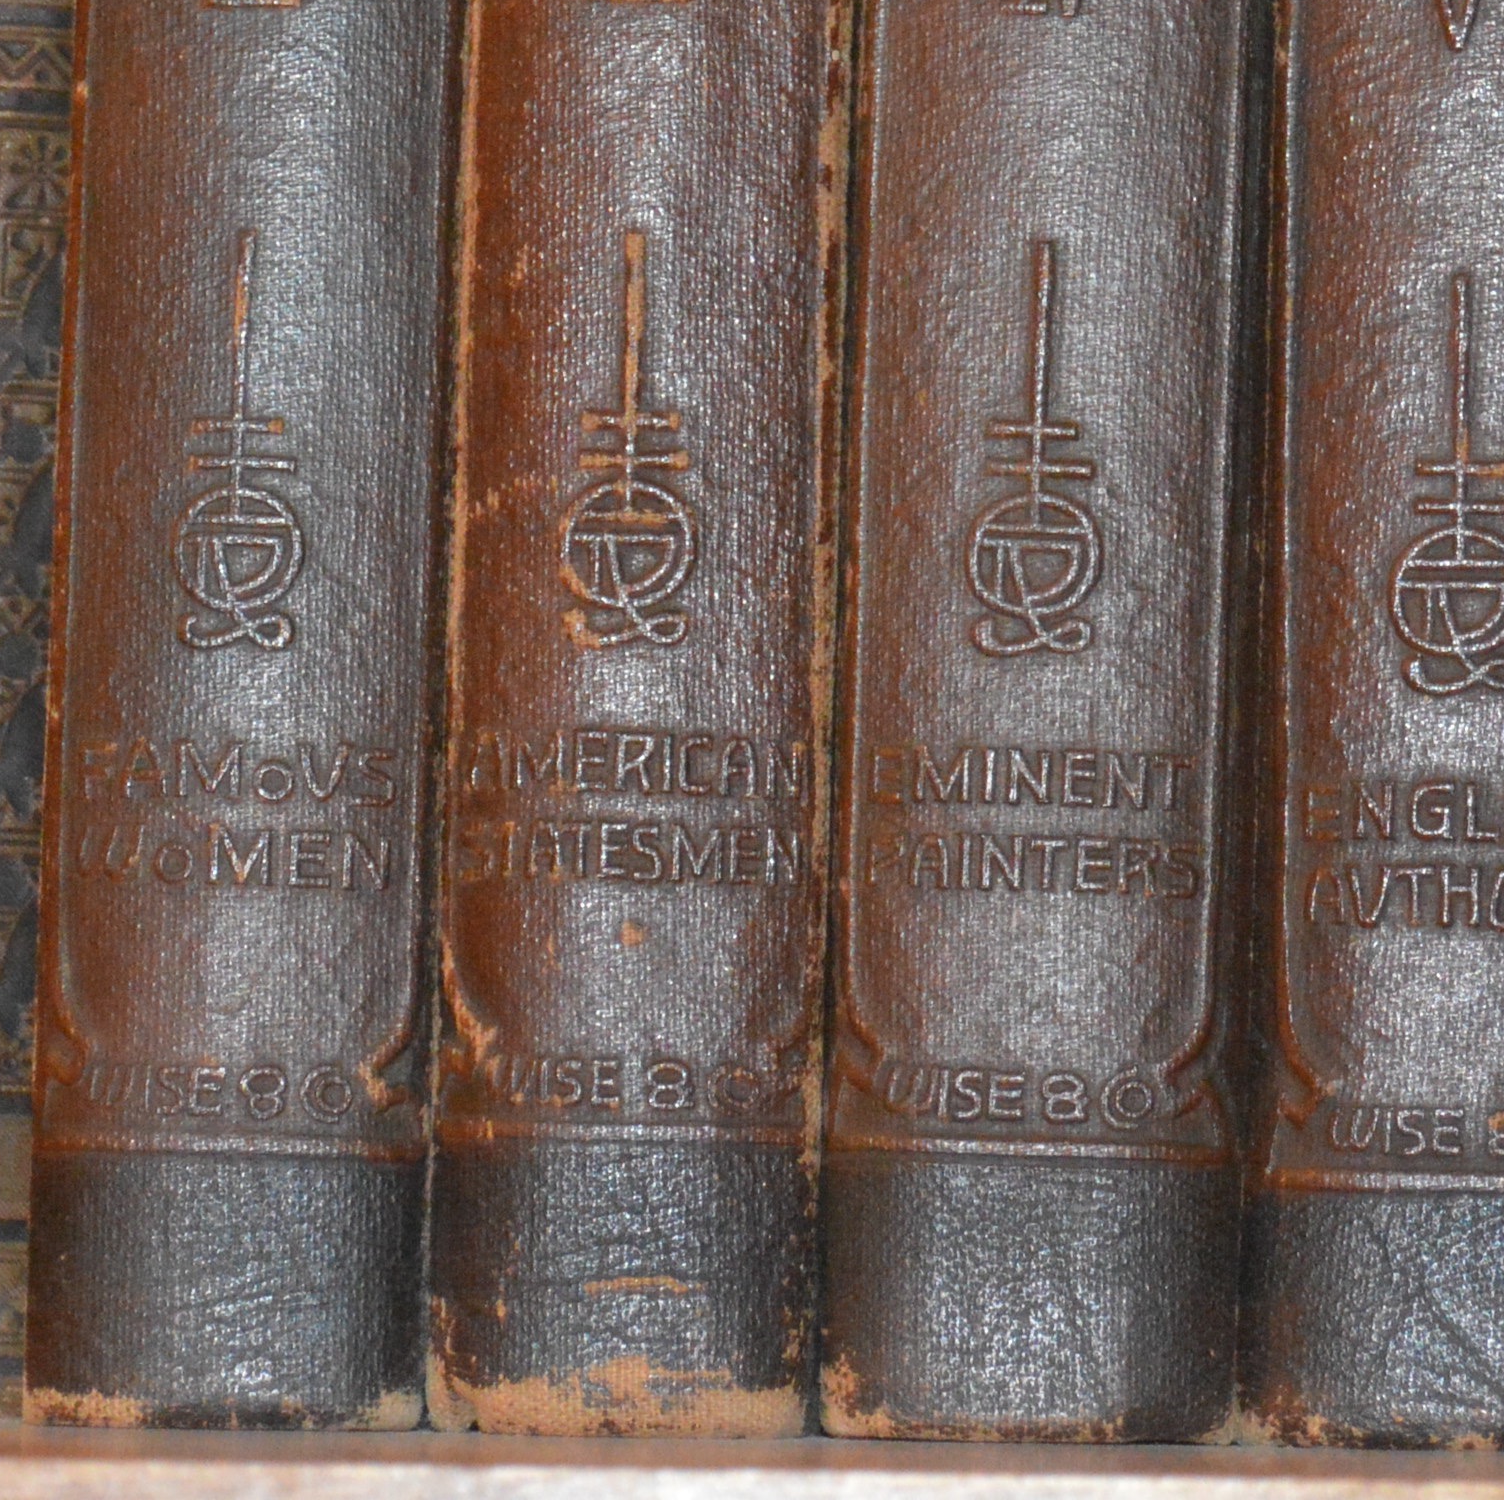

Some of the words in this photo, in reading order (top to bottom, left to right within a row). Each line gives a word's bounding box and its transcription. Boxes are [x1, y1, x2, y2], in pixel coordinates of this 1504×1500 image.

[466, 730, 807, 797] AMERICAN
[871, 747, 1194, 811] EMINENT
[460, 820, 802, 886] STATESMEN
[866, 833, 1202, 898] PAINTERS
[89, 1062, 227, 1116] WISE
[498, 1056, 619, 1108] WISE
[883, 1067, 1026, 1121] WISE
[1330, 1105, 1465, 1157] WISE
